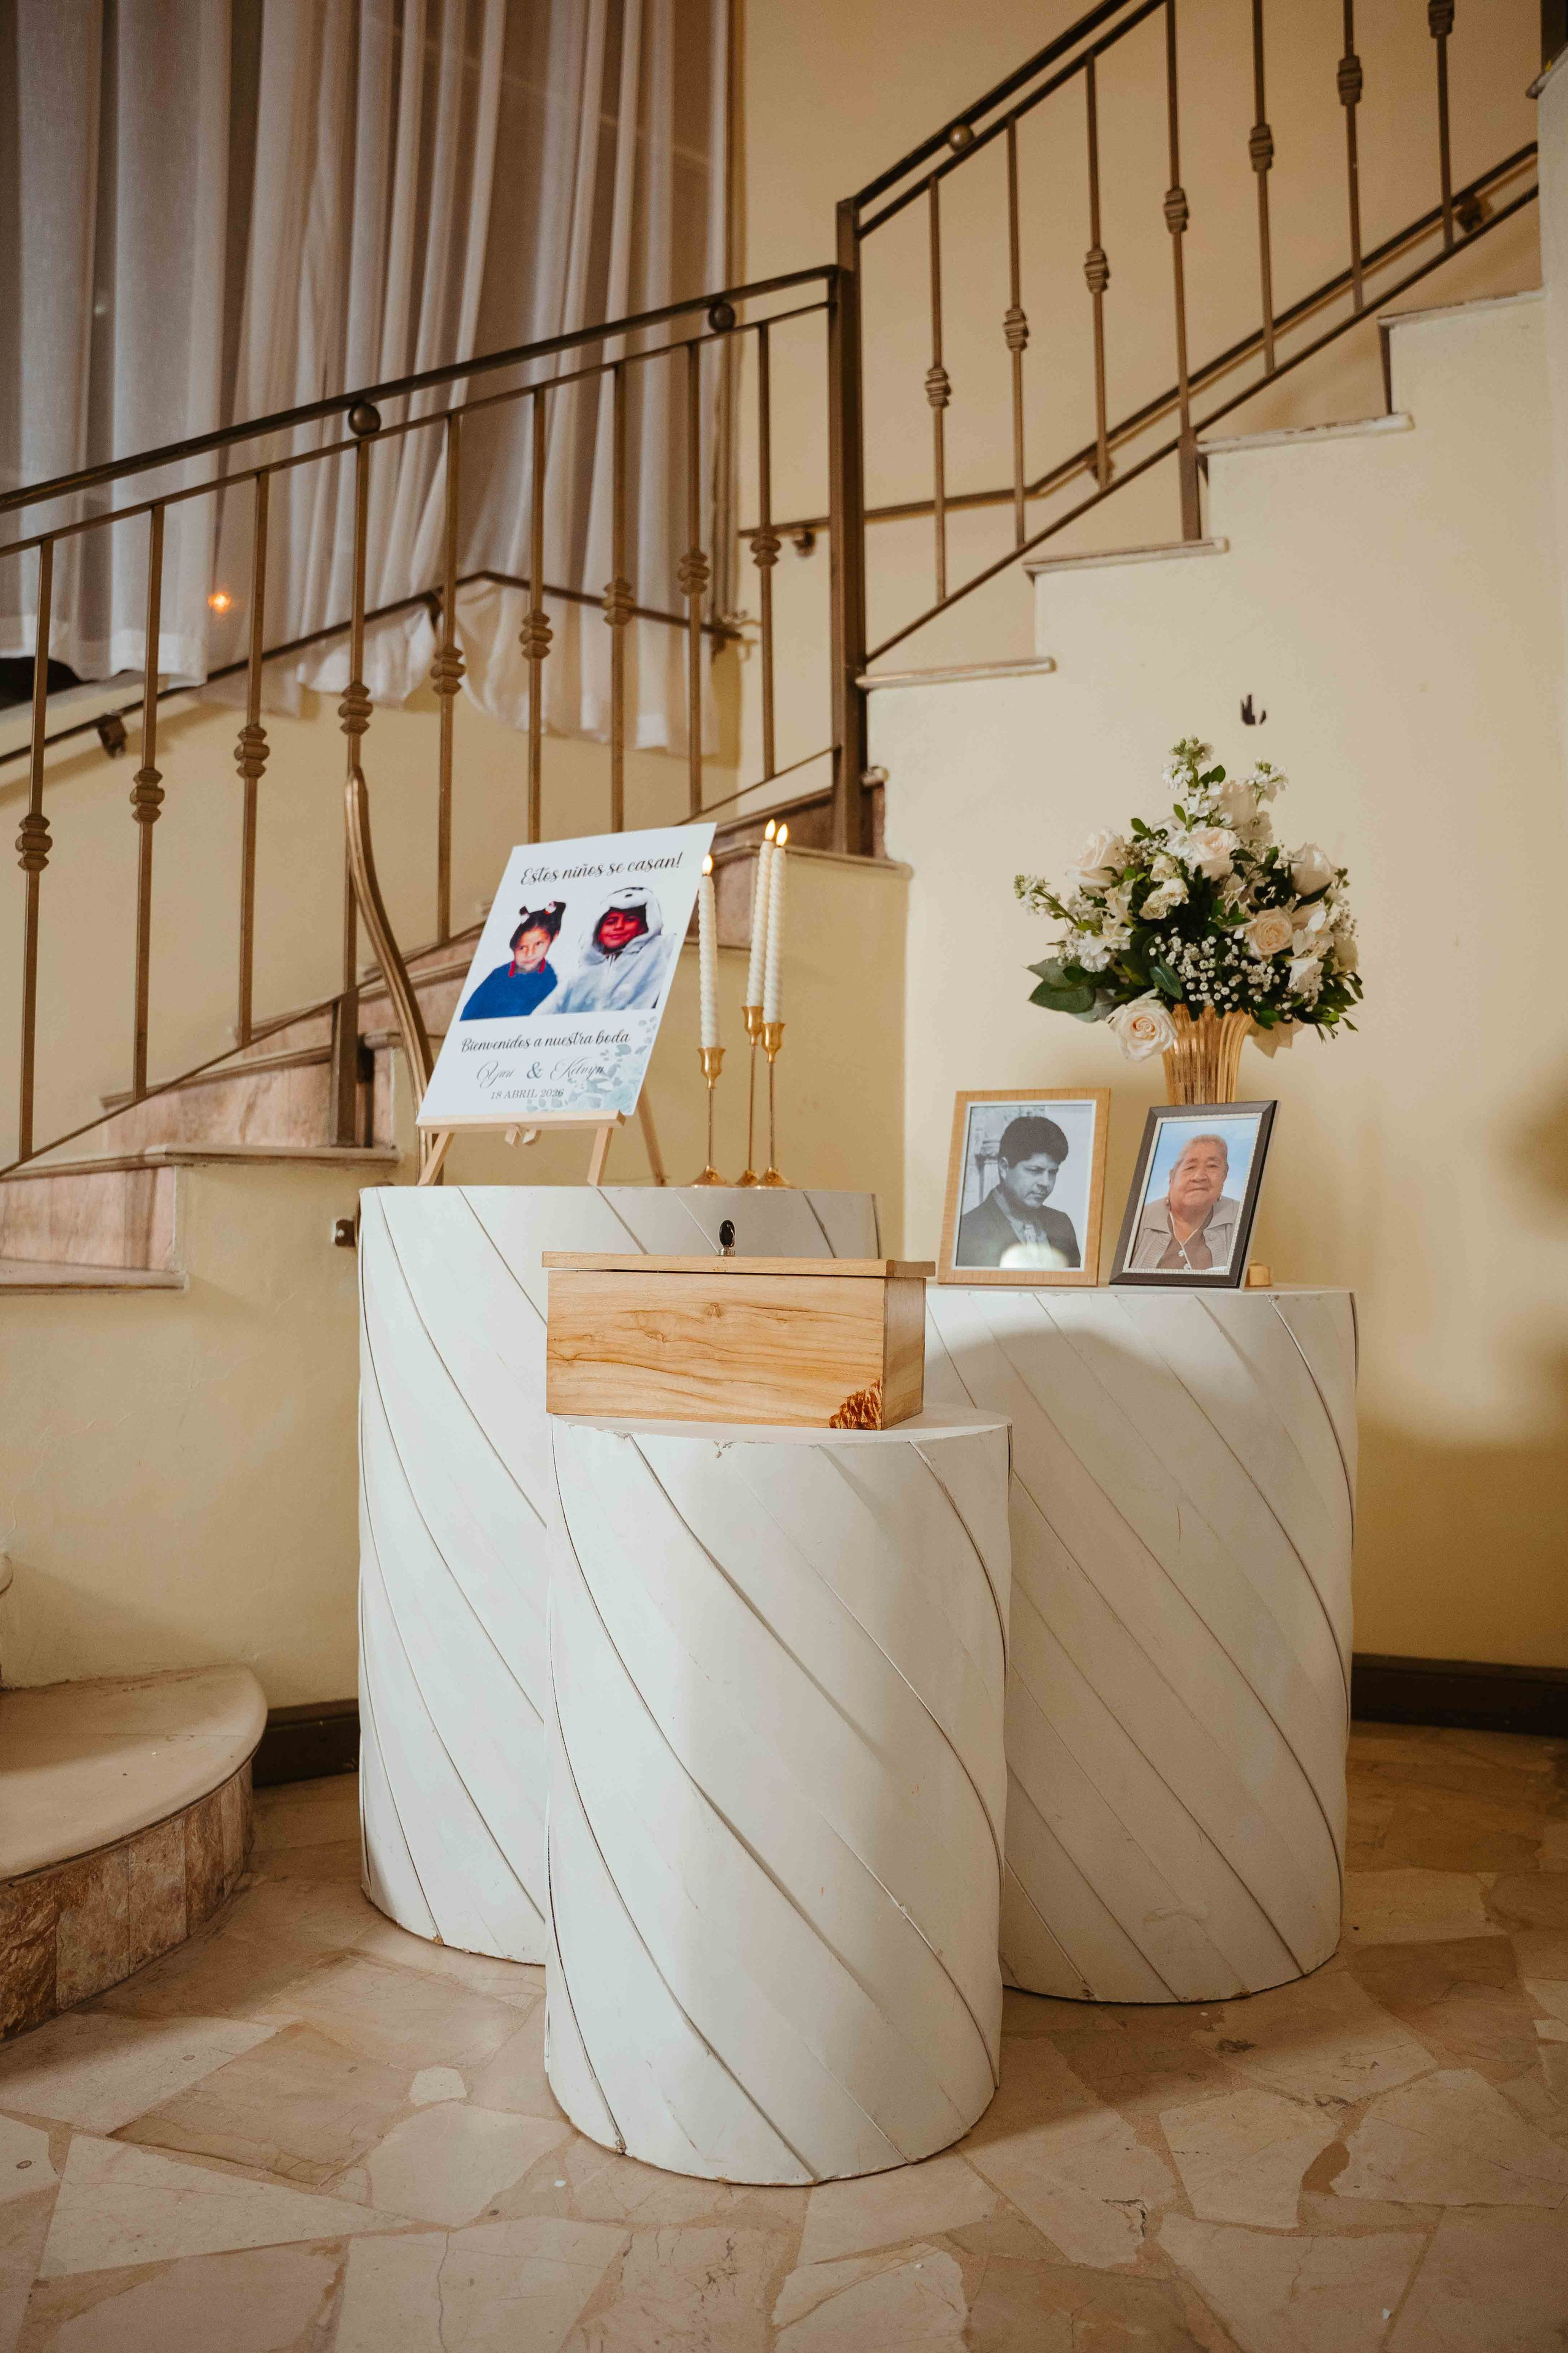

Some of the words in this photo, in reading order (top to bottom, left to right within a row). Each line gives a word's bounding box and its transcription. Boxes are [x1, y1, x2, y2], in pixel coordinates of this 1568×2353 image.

[521, 867, 557, 885] Estos
[562, 863, 603, 880] niños
[607, 863, 624, 877] se
[628, 852, 683, 872] casan!
[461, 1035, 530, 1052] Bienvenidos
[533, 1037, 541, 1047] a
[545, 1031, 592, 1046] nuestra
[596, 1029, 629, 1044] boda
[527, 1062, 542, 1079] &
[503, 1089, 537, 1099] ABRIL
[540, 1089, 564, 1098] 2026
